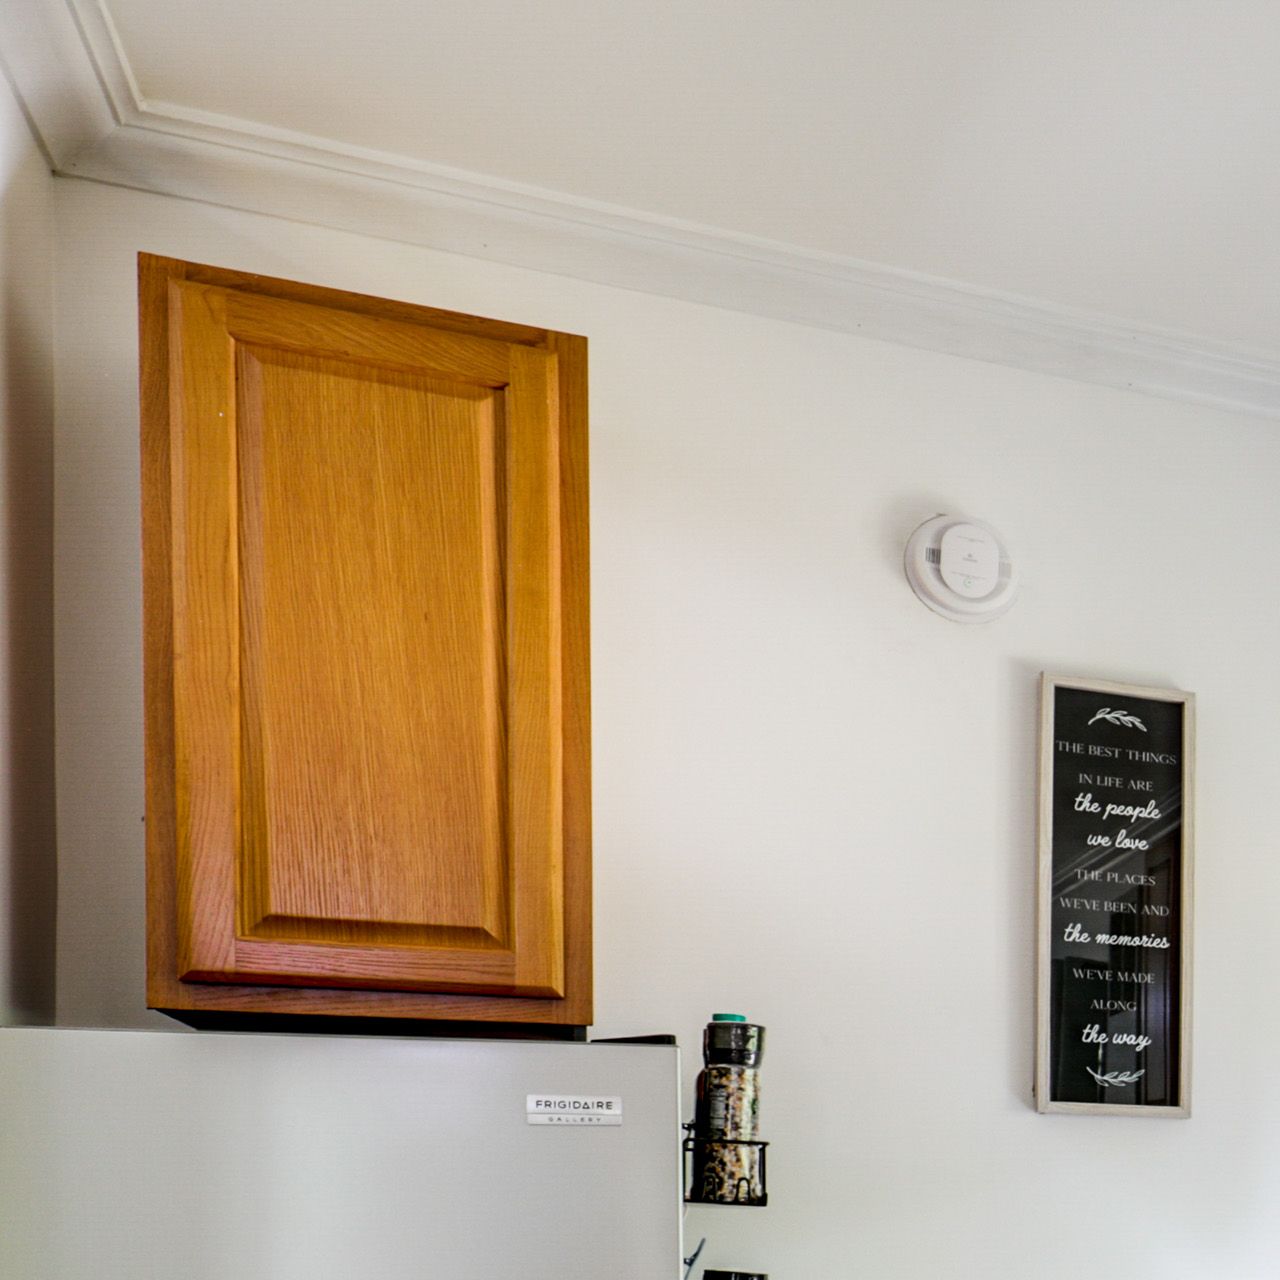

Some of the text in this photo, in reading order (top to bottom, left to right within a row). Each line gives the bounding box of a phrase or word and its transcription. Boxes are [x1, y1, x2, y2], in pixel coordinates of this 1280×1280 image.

[1057, 740, 1177, 765] THE BEST THINGS
[1079, 773, 1154, 792] IN LIFE ARE
[1074, 792, 1162, 823] the people
[1086, 829, 1150, 851] we love
[1074, 868, 1157, 887] THE PLACES
[1060, 896, 1170, 917] WE'VE BEEN AND
[1063, 922, 1171, 949] the memories
[1072, 967, 1156, 984] WE'VE MADE
[1090, 999, 1138, 1012] ALONG
[1082, 1024, 1153, 1052] the way
[535, 1100, 614, 1111] FRIGIDAIRE
